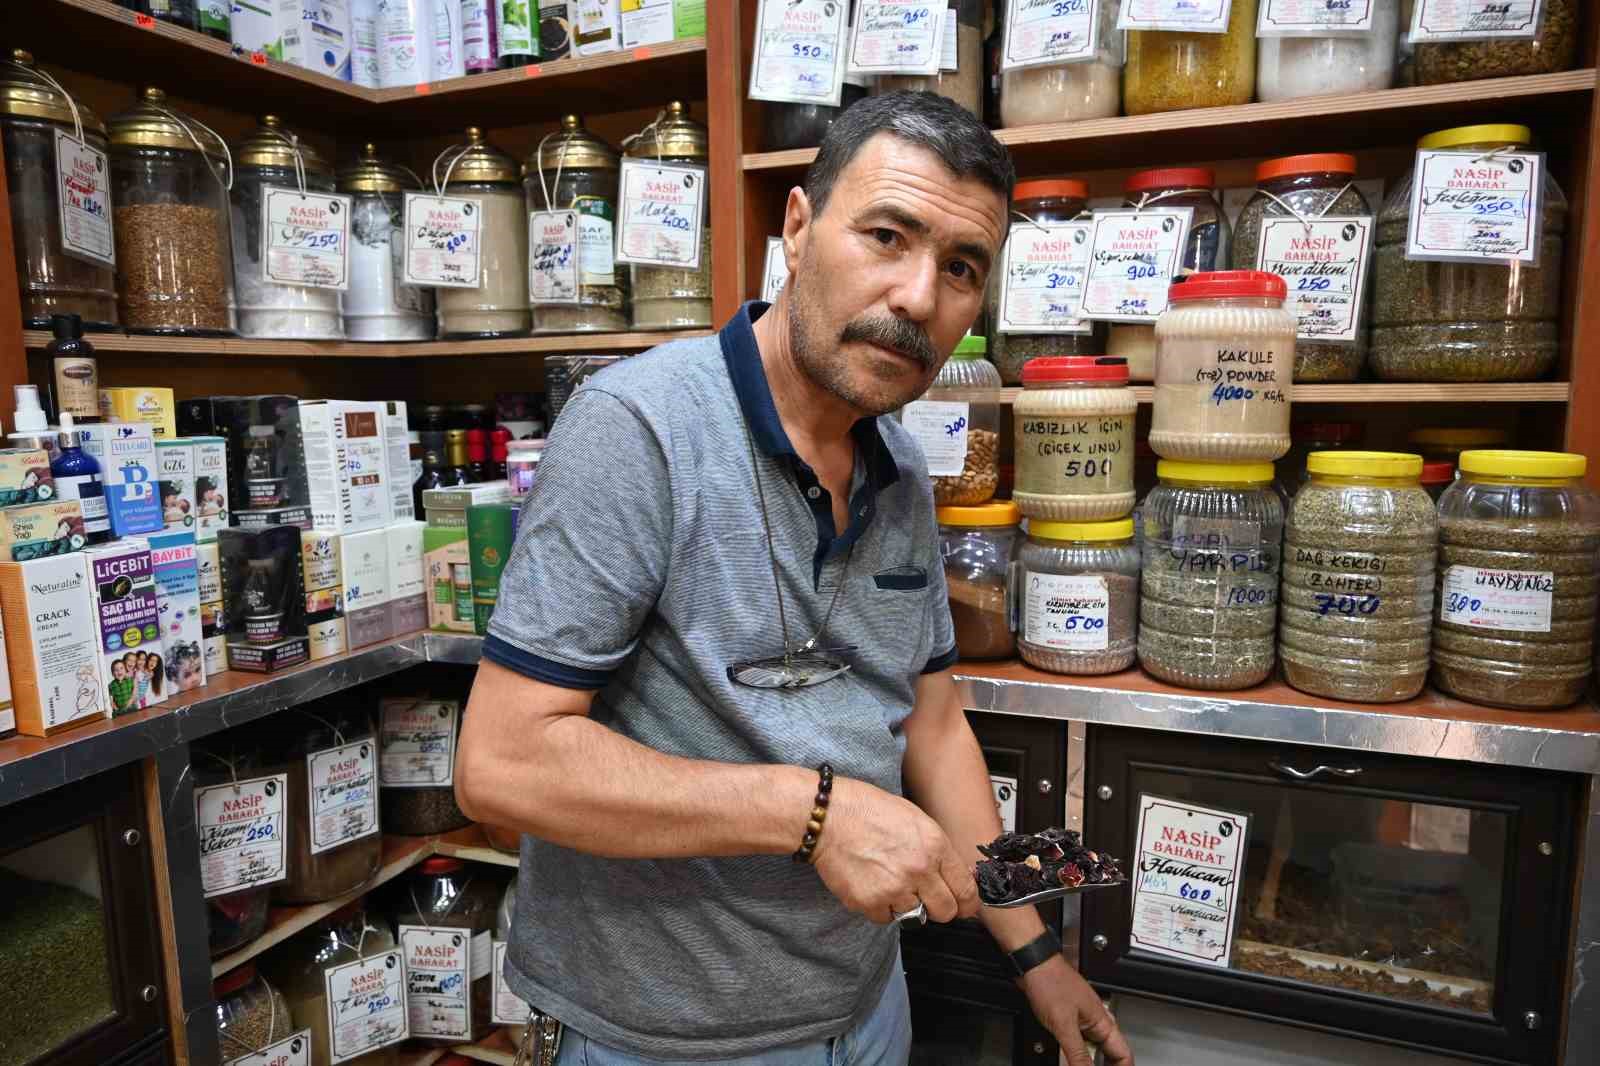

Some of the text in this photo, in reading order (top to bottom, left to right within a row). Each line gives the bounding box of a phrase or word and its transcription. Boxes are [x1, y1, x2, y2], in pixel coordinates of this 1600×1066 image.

[1453, 167, 1504, 179] NASİP
[1447, 180, 1508, 190] BAHARAT
[288, 206, 326, 219] NASİP
[428, 209, 463, 221] NASİP
[1472, 200, 1514, 215] 350
[308, 234, 338, 248] 250
[1119, 227, 1158, 241] NASİP
[1032, 240, 1073, 253] NASİP
[1289, 236, 1337, 250] NASİP
[1284, 252, 1341, 262] BAHARAT
[1127, 265, 1158, 281] 900
[1046, 273, 1076, 289] 300
[1297, 277, 1331, 292] 250
[1217, 349, 1274, 365] KAKULE
[1226, 369, 1277, 383] POWDER
[1212, 382, 1255, 406] 4000
[1023, 417, 1123, 436] KABIZLIK İÇİN
[1088, 439, 1121, 456] UNU)
[1064, 457, 1113, 478] 500
[36, 607, 72, 624] CRACK
[102, 602, 124, 617] SAÇ
[1065, 616, 1105, 630] 500
[329, 757, 360, 774] NASİP
[223, 794, 264, 814] NASİP
[218, 807, 266, 824] BAHARAT
[246, 823, 274, 842] 250
[1161, 825, 1223, 850] NASİP
[1153, 840, 1227, 866] BAHARAT
[1180, 882, 1212, 902] 600
[414, 943, 457, 957] NASİP
[410, 957, 458, 968] BAHARAT
[351, 966, 385, 987] NASİP
